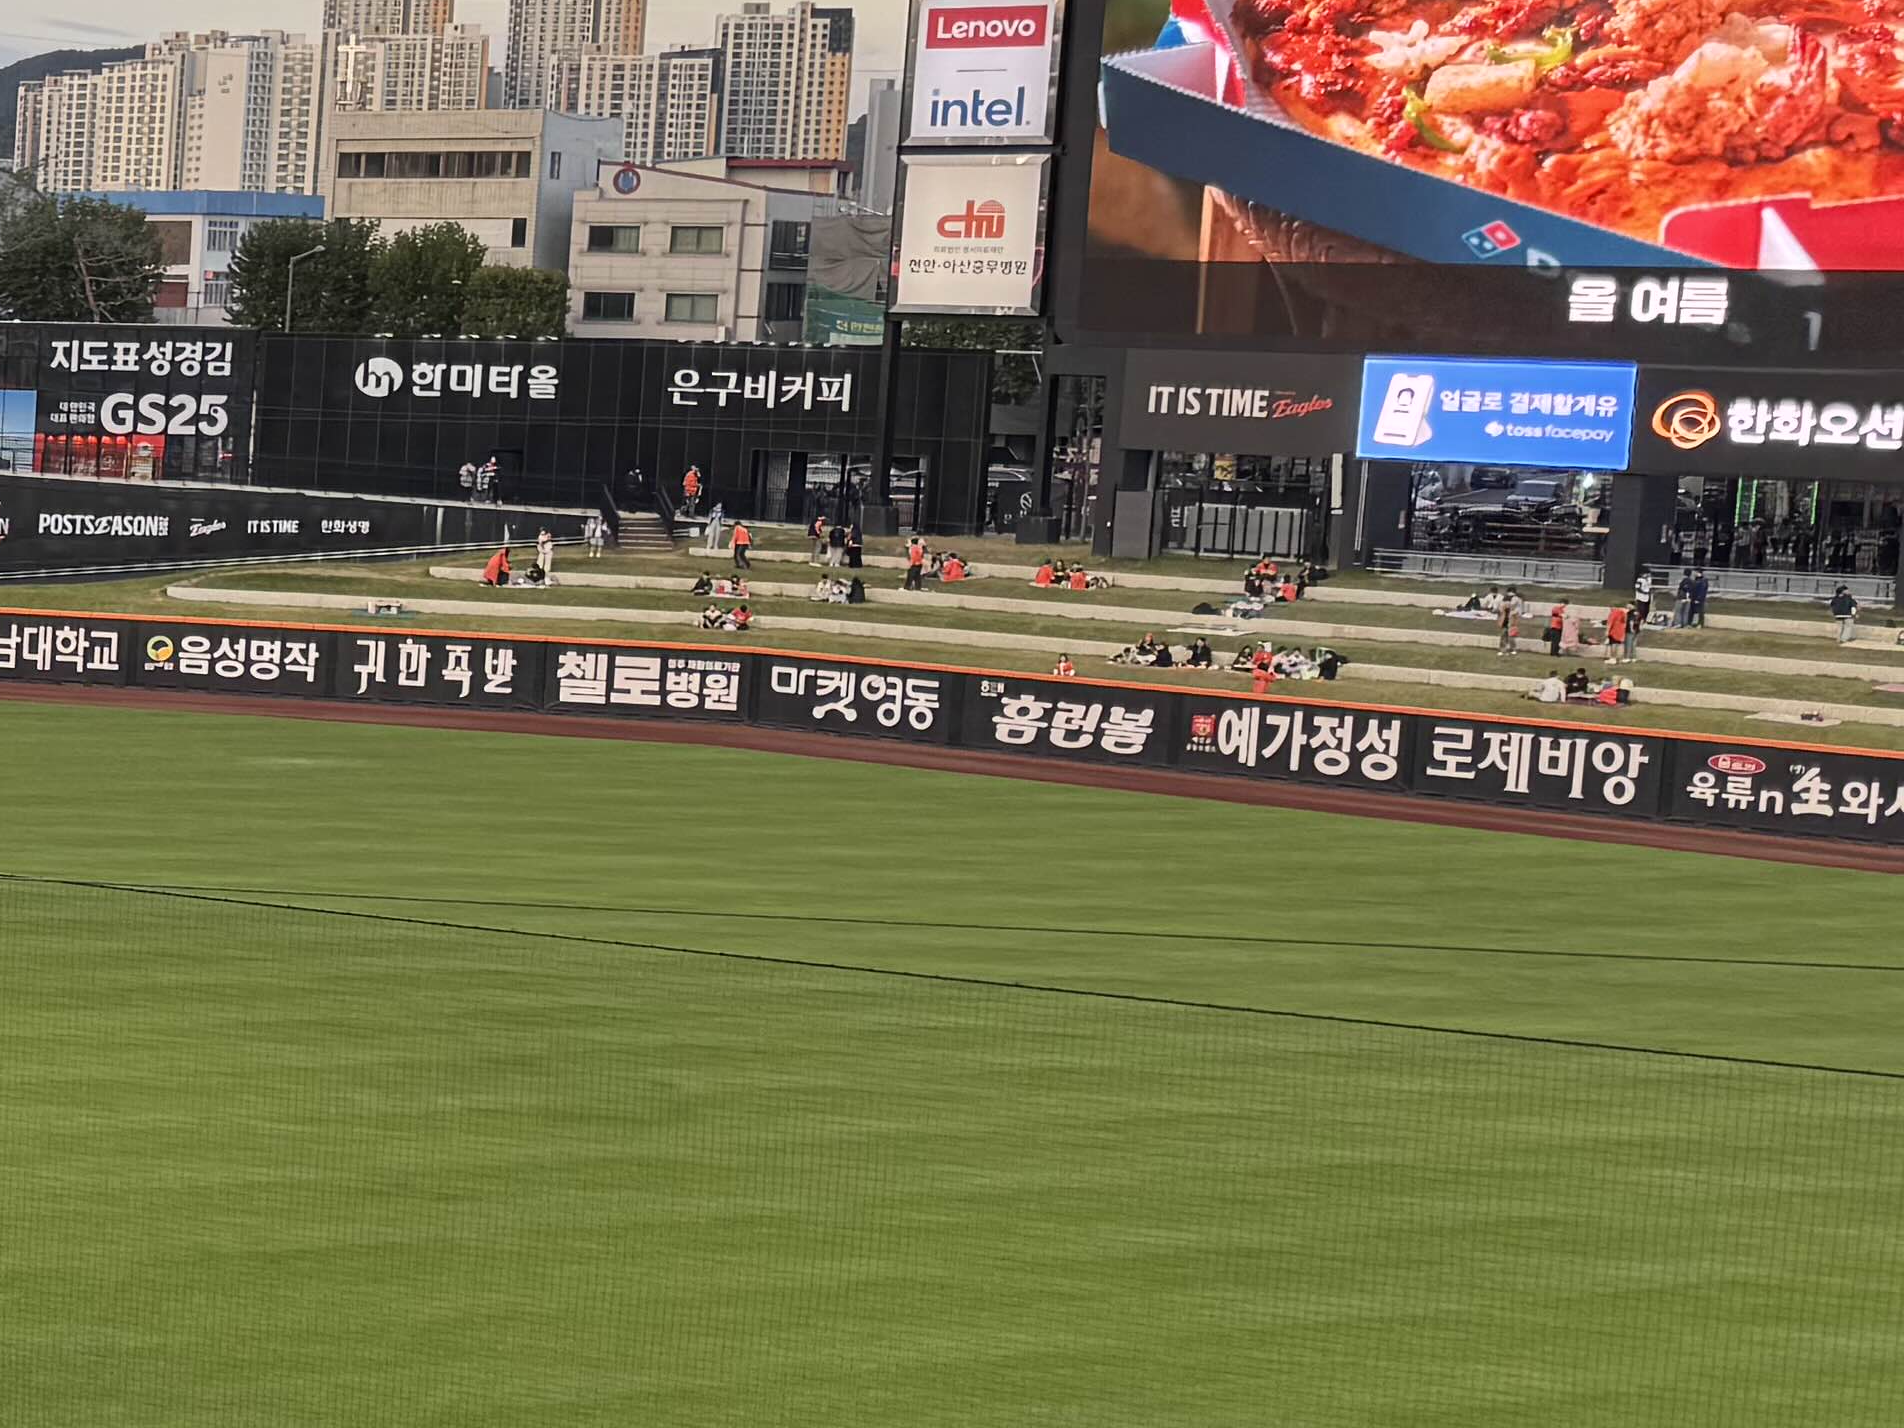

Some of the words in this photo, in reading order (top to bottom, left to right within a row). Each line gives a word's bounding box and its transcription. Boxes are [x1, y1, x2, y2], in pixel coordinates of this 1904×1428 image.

[937, 16, 1036, 39] Lenovo
[1568, 277, 1617, 323] 올
[1630, 276, 1729, 325] 여름
[411, 361, 560, 401] 한미타올
[668, 369, 852, 412] 은구비커피
[1147, 385, 1175, 415] IT
[1178, 386, 1200, 416] IS
[1205, 388, 1269, 419] TIME
[1272, 396, 1334, 420] Eagles
[1440, 388, 1502, 414] 얼굴로
[101, 393, 228, 436] GS25
[1727, 395, 1904, 450] 한화오션
[178, 635, 320, 683] 음성명작
[556, 650, 662, 706] 첼로
[665, 672, 741, 712] 병원
[992, 694, 1155, 755] 홈런볼
[1217, 706, 1402, 781] 예가정성
[1426, 724, 1650, 805] 로제비앙
